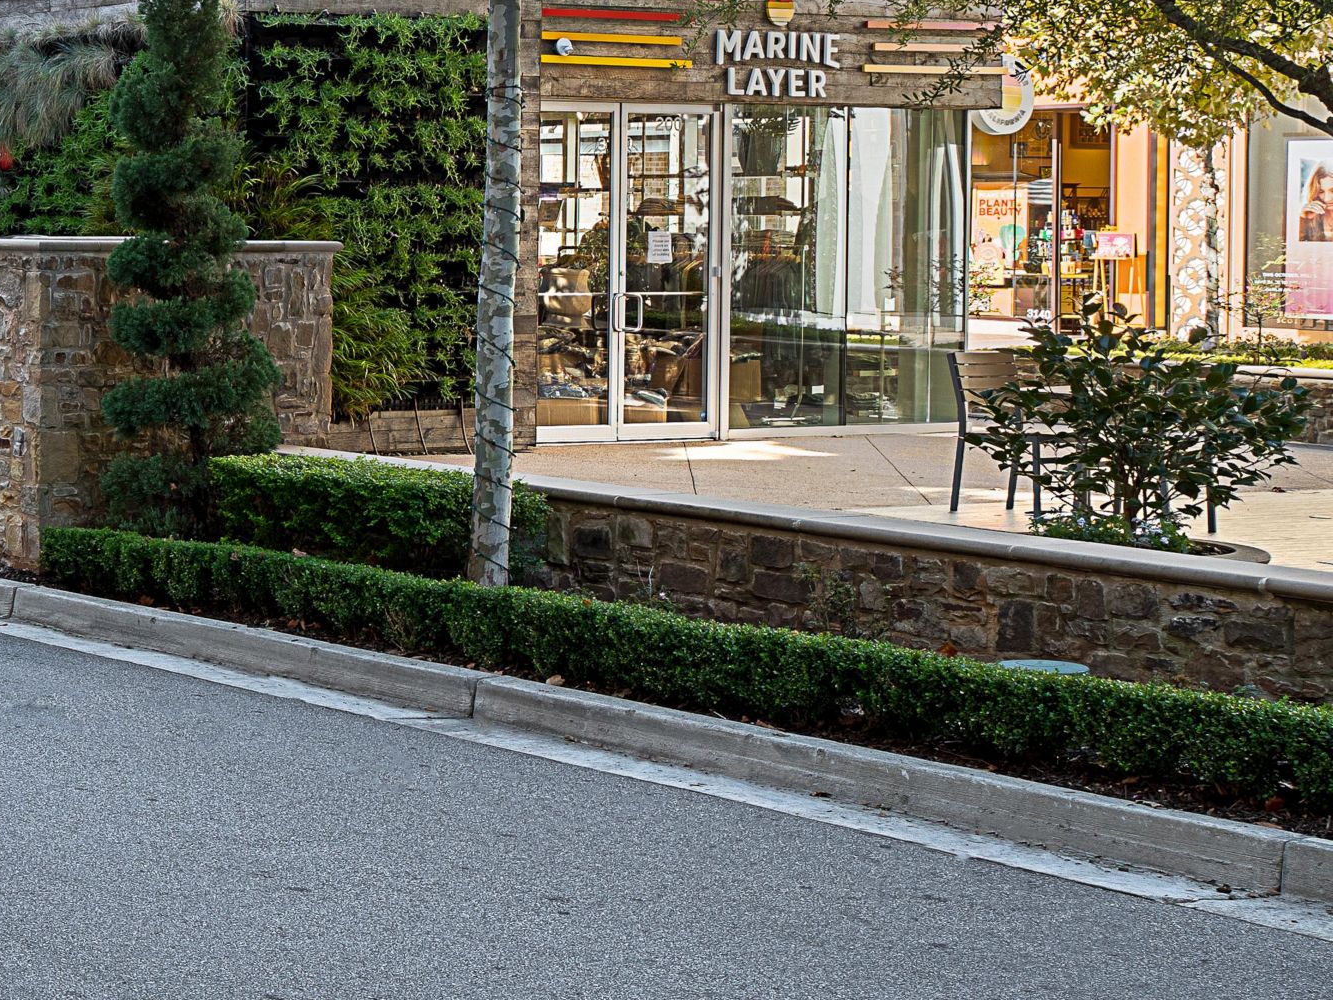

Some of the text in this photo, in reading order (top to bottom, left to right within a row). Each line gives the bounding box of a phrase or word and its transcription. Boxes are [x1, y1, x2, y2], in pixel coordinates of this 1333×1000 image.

[715, 29, 841, 69] MARINE
[727, 67, 827, 98] LAYER
[655, 116, 683, 132] 200
[979, 207, 1022, 216] BEAUTY
[1026, 308, 1051, 320] 3140
